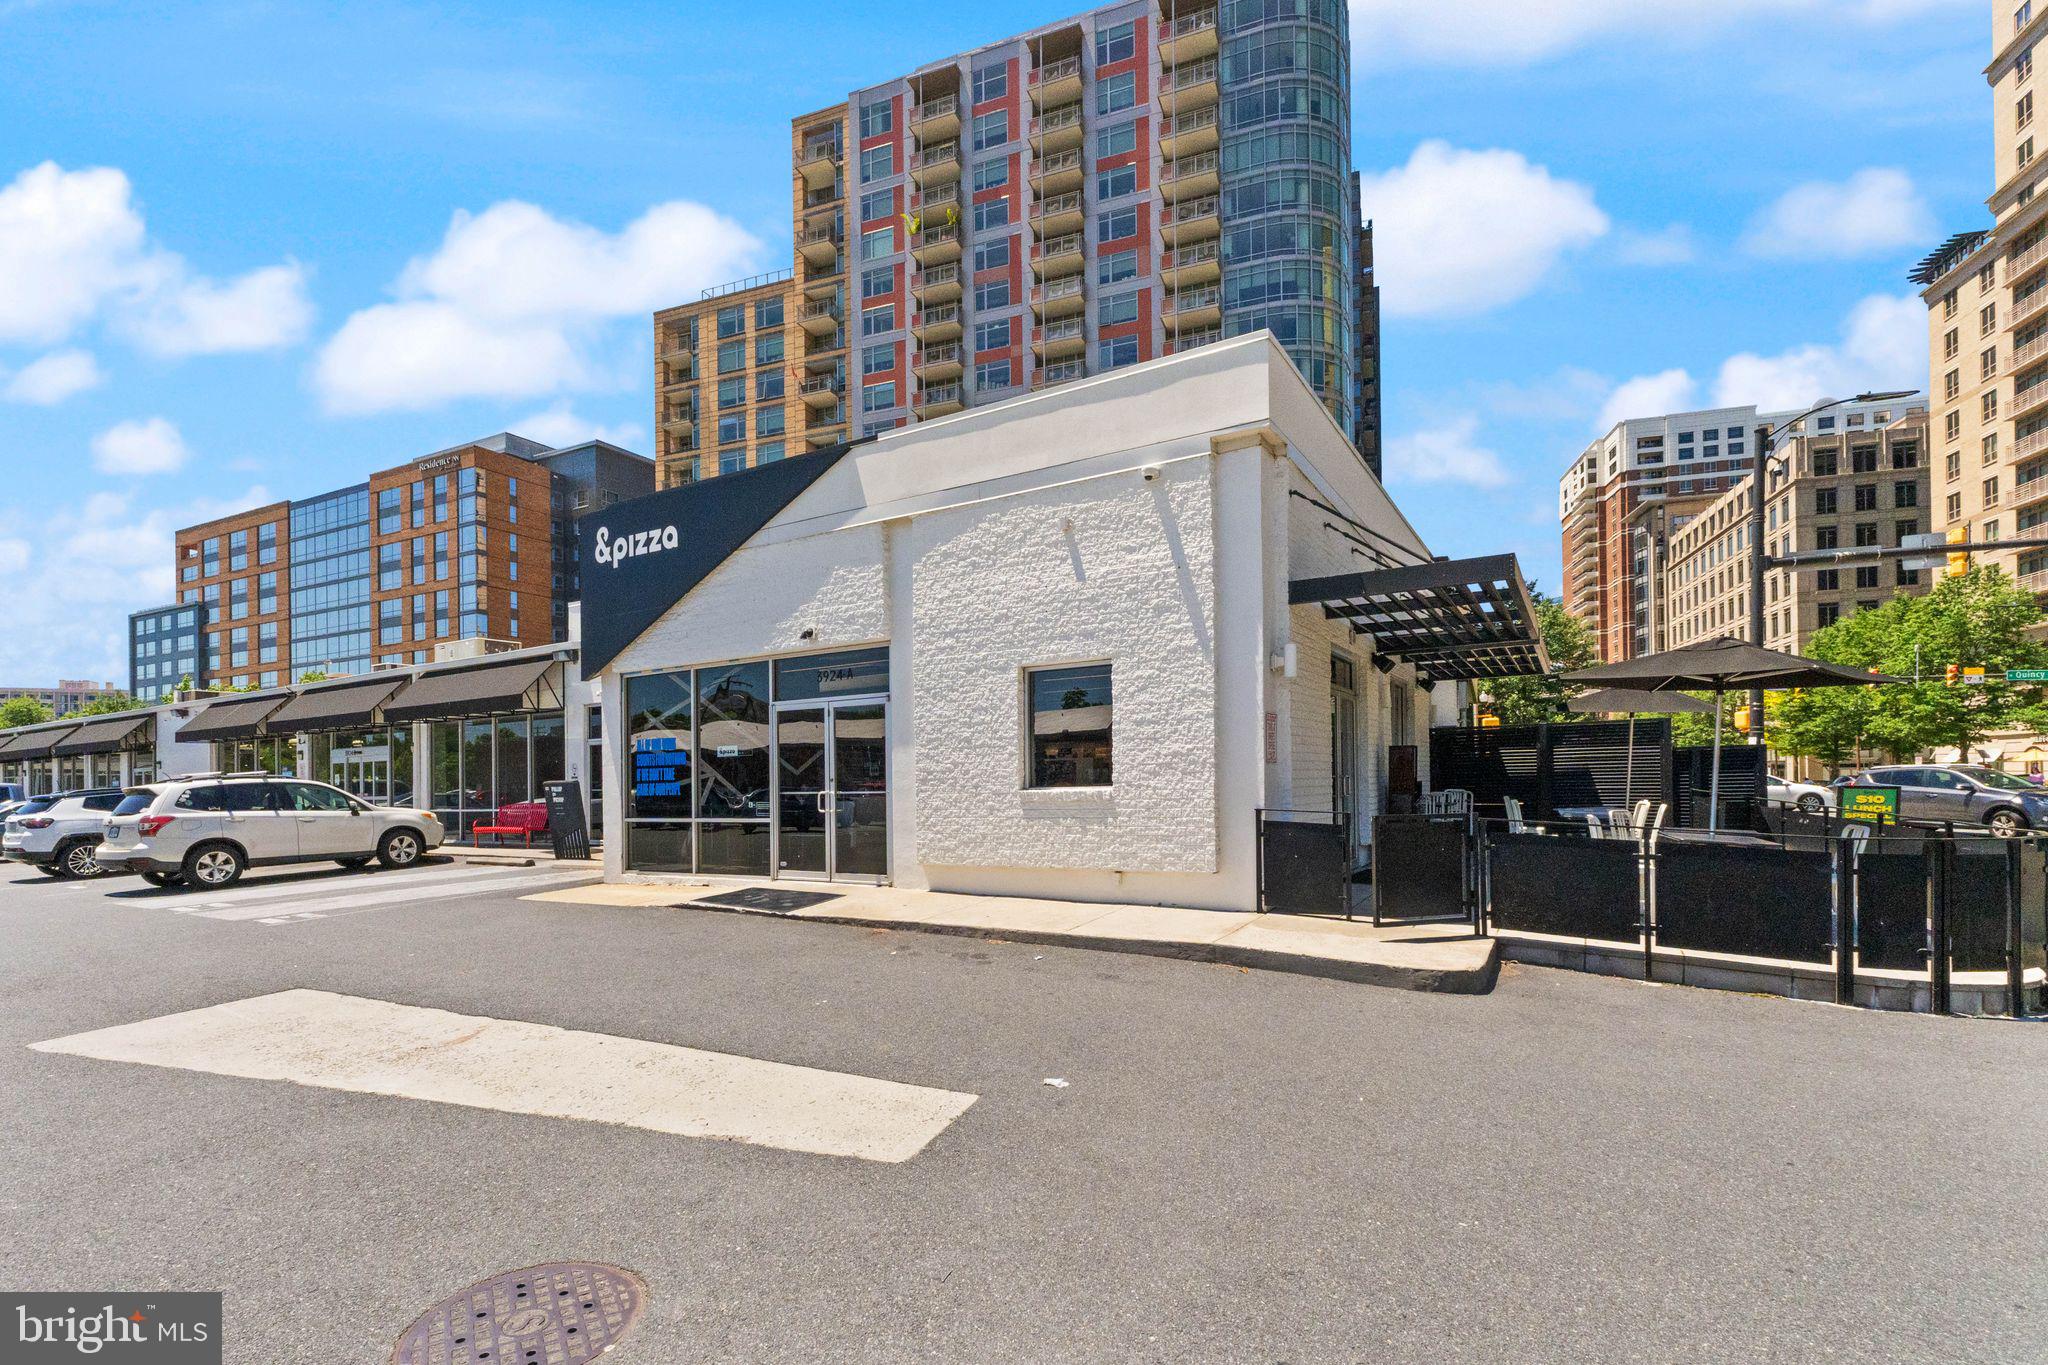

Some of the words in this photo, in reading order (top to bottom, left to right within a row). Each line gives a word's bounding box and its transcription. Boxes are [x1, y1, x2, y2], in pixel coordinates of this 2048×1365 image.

[418, 456, 451, 472] Residence
[594, 525, 679, 569] &pizza
[2015, 670, 2046, 680] Quincy
[1844, 804, 1893, 813] LUNCH
